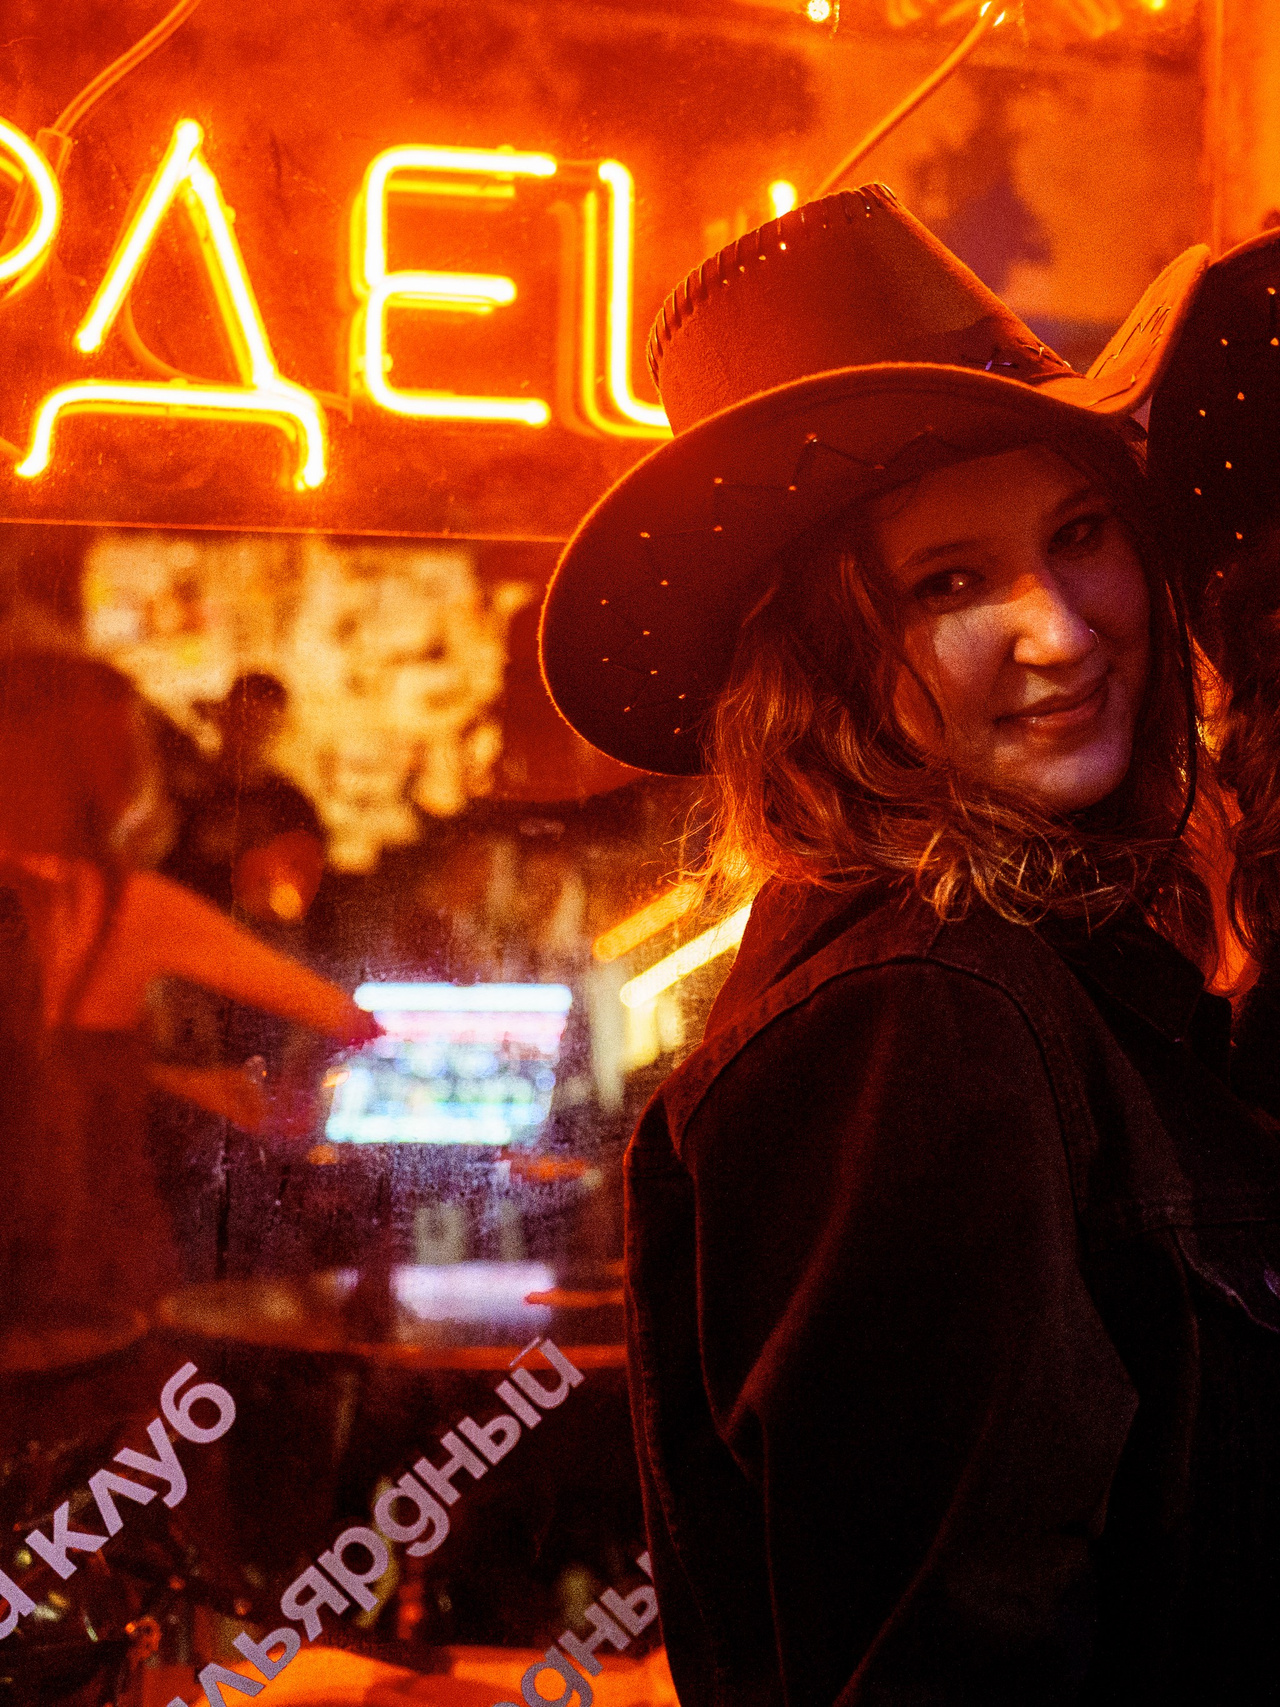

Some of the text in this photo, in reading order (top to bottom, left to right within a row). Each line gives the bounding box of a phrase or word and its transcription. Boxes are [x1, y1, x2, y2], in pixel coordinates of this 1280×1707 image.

[24, 1361, 237, 1580] клуб
[165, 1336, 586, 1707] льярдный
[491, 1551, 660, 1707] дны
